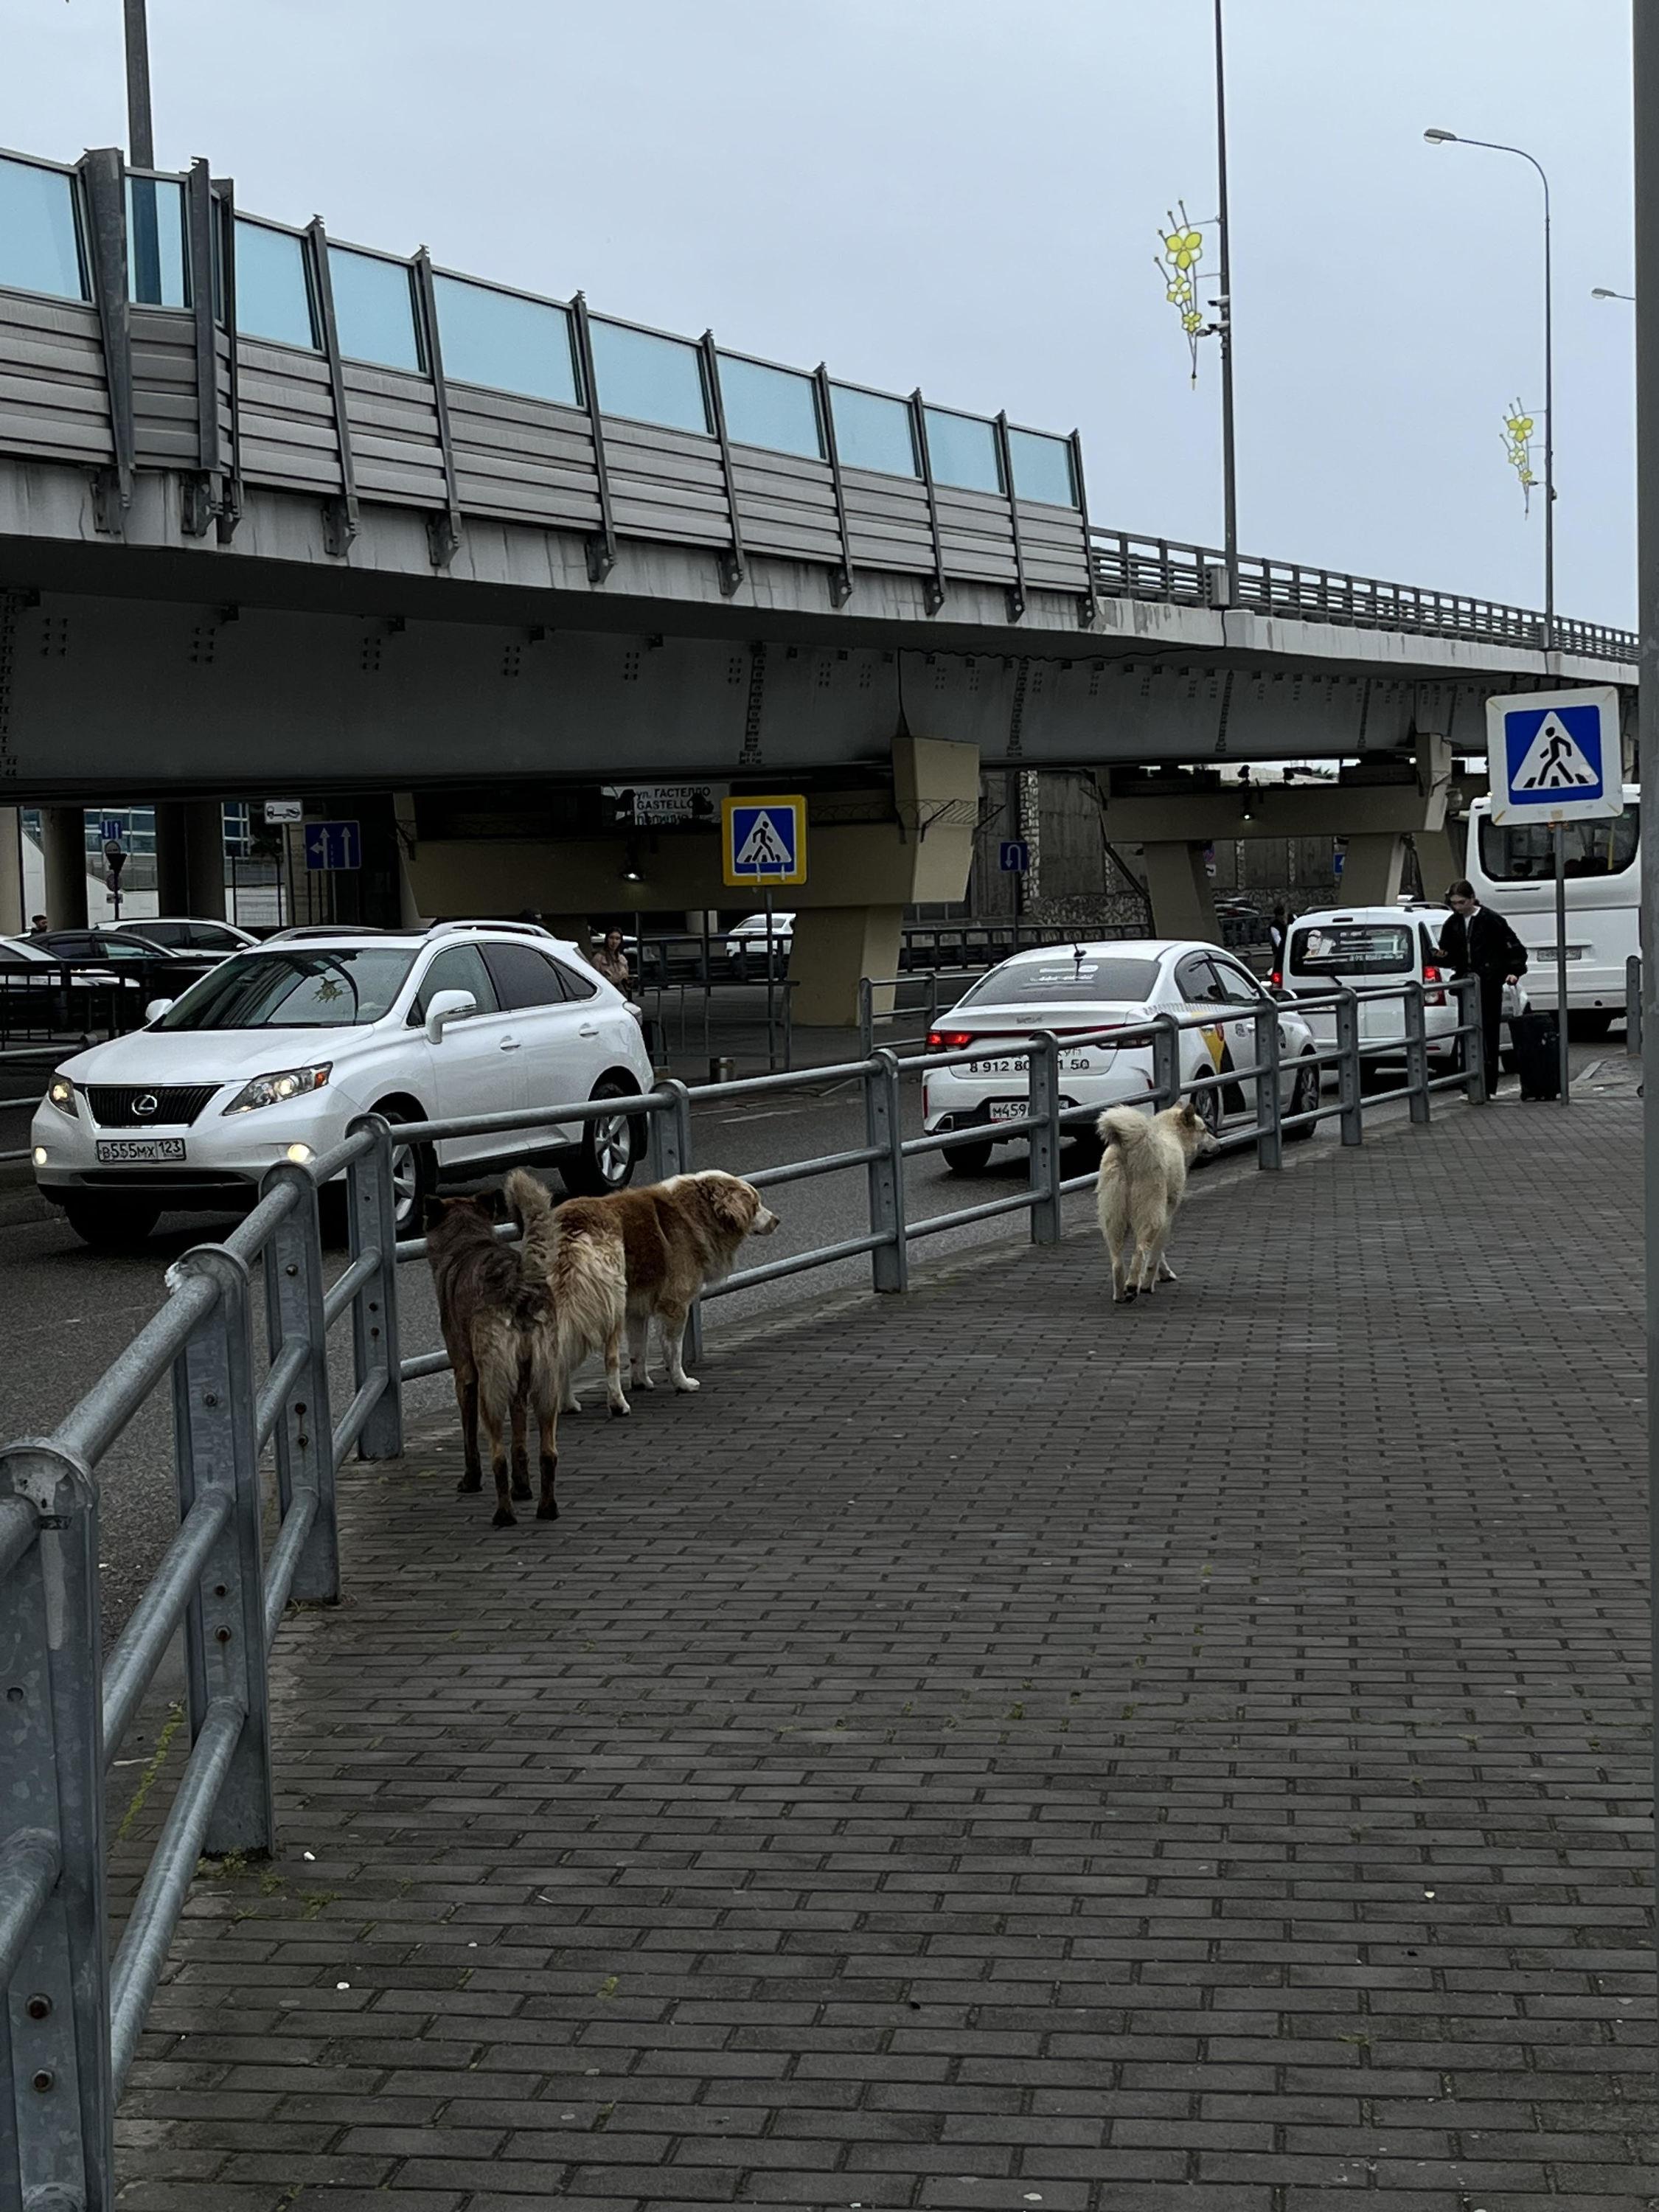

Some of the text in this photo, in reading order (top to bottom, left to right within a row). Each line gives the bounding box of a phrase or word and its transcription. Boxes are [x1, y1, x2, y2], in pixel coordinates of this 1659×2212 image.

[970, 1062, 978, 1072] 8
[982, 1060, 1009, 1072] 912
[1071, 1058, 1090, 1070] 50
[159, 1141, 181, 1154] 123
